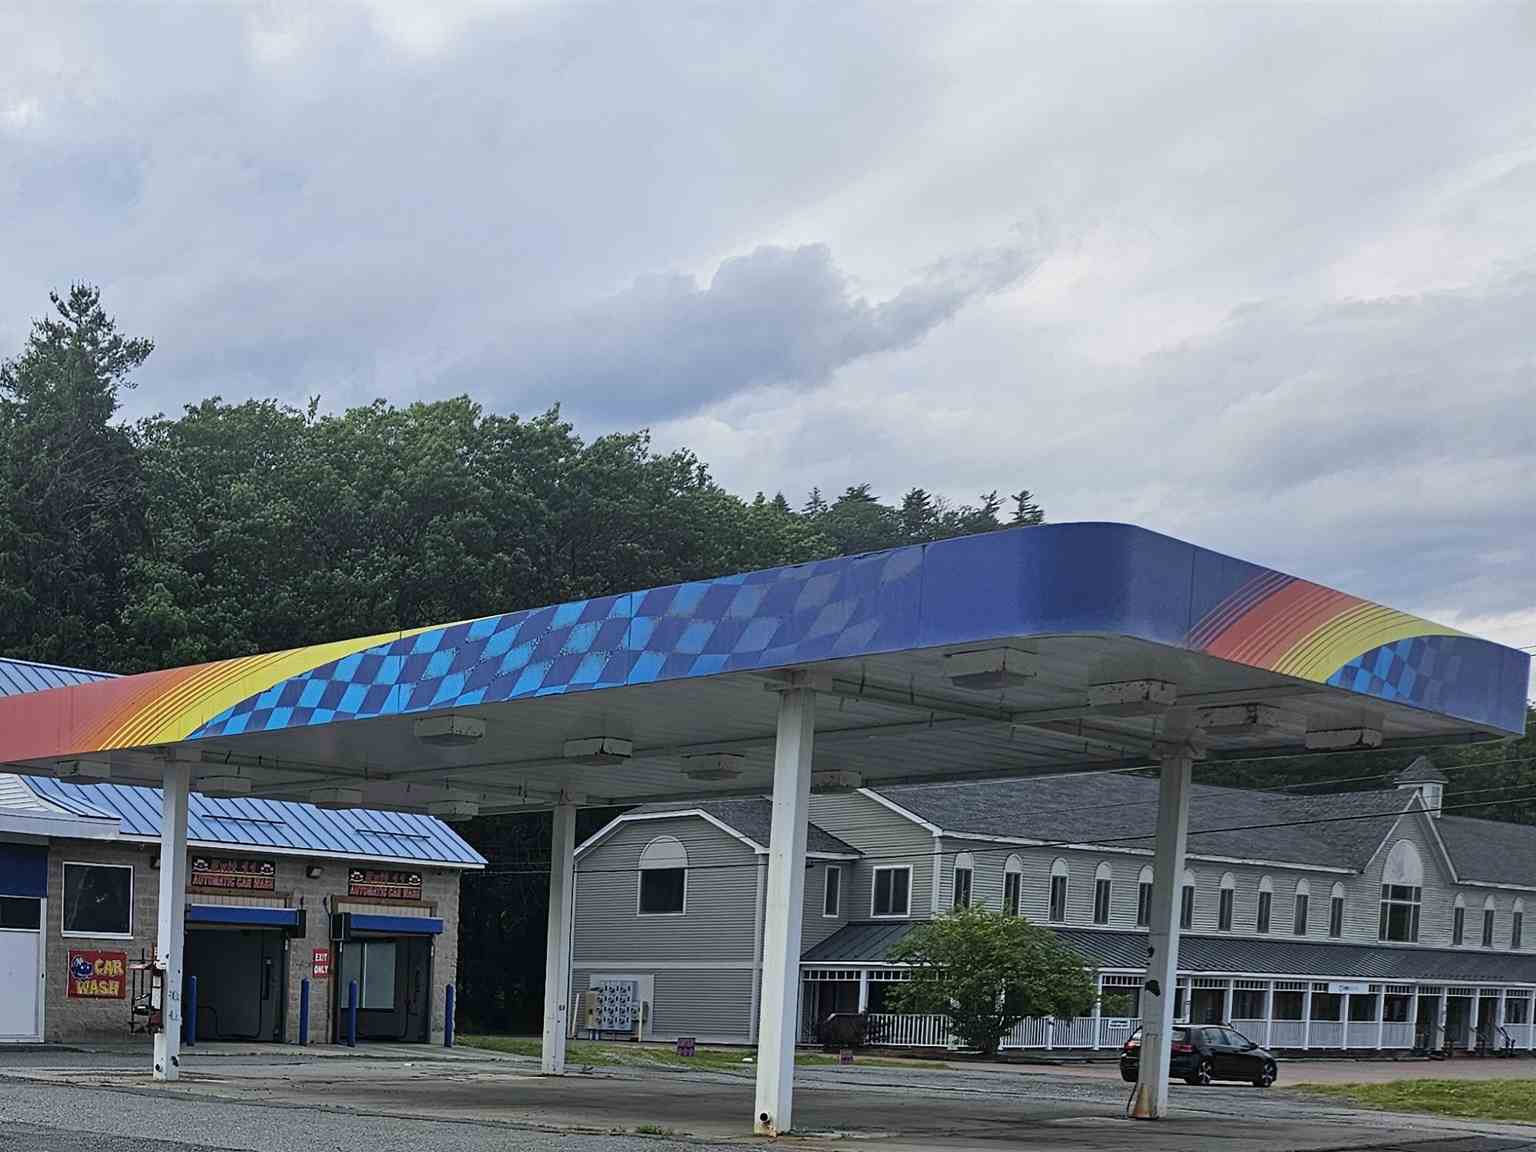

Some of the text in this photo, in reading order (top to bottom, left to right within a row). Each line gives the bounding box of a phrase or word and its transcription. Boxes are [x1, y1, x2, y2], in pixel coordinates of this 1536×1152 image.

[315, 953, 327, 961] EXIT
[95, 959, 124, 977] CAR
[314, 965, 328, 974] ONLY
[75, 979, 120, 996] WASH
